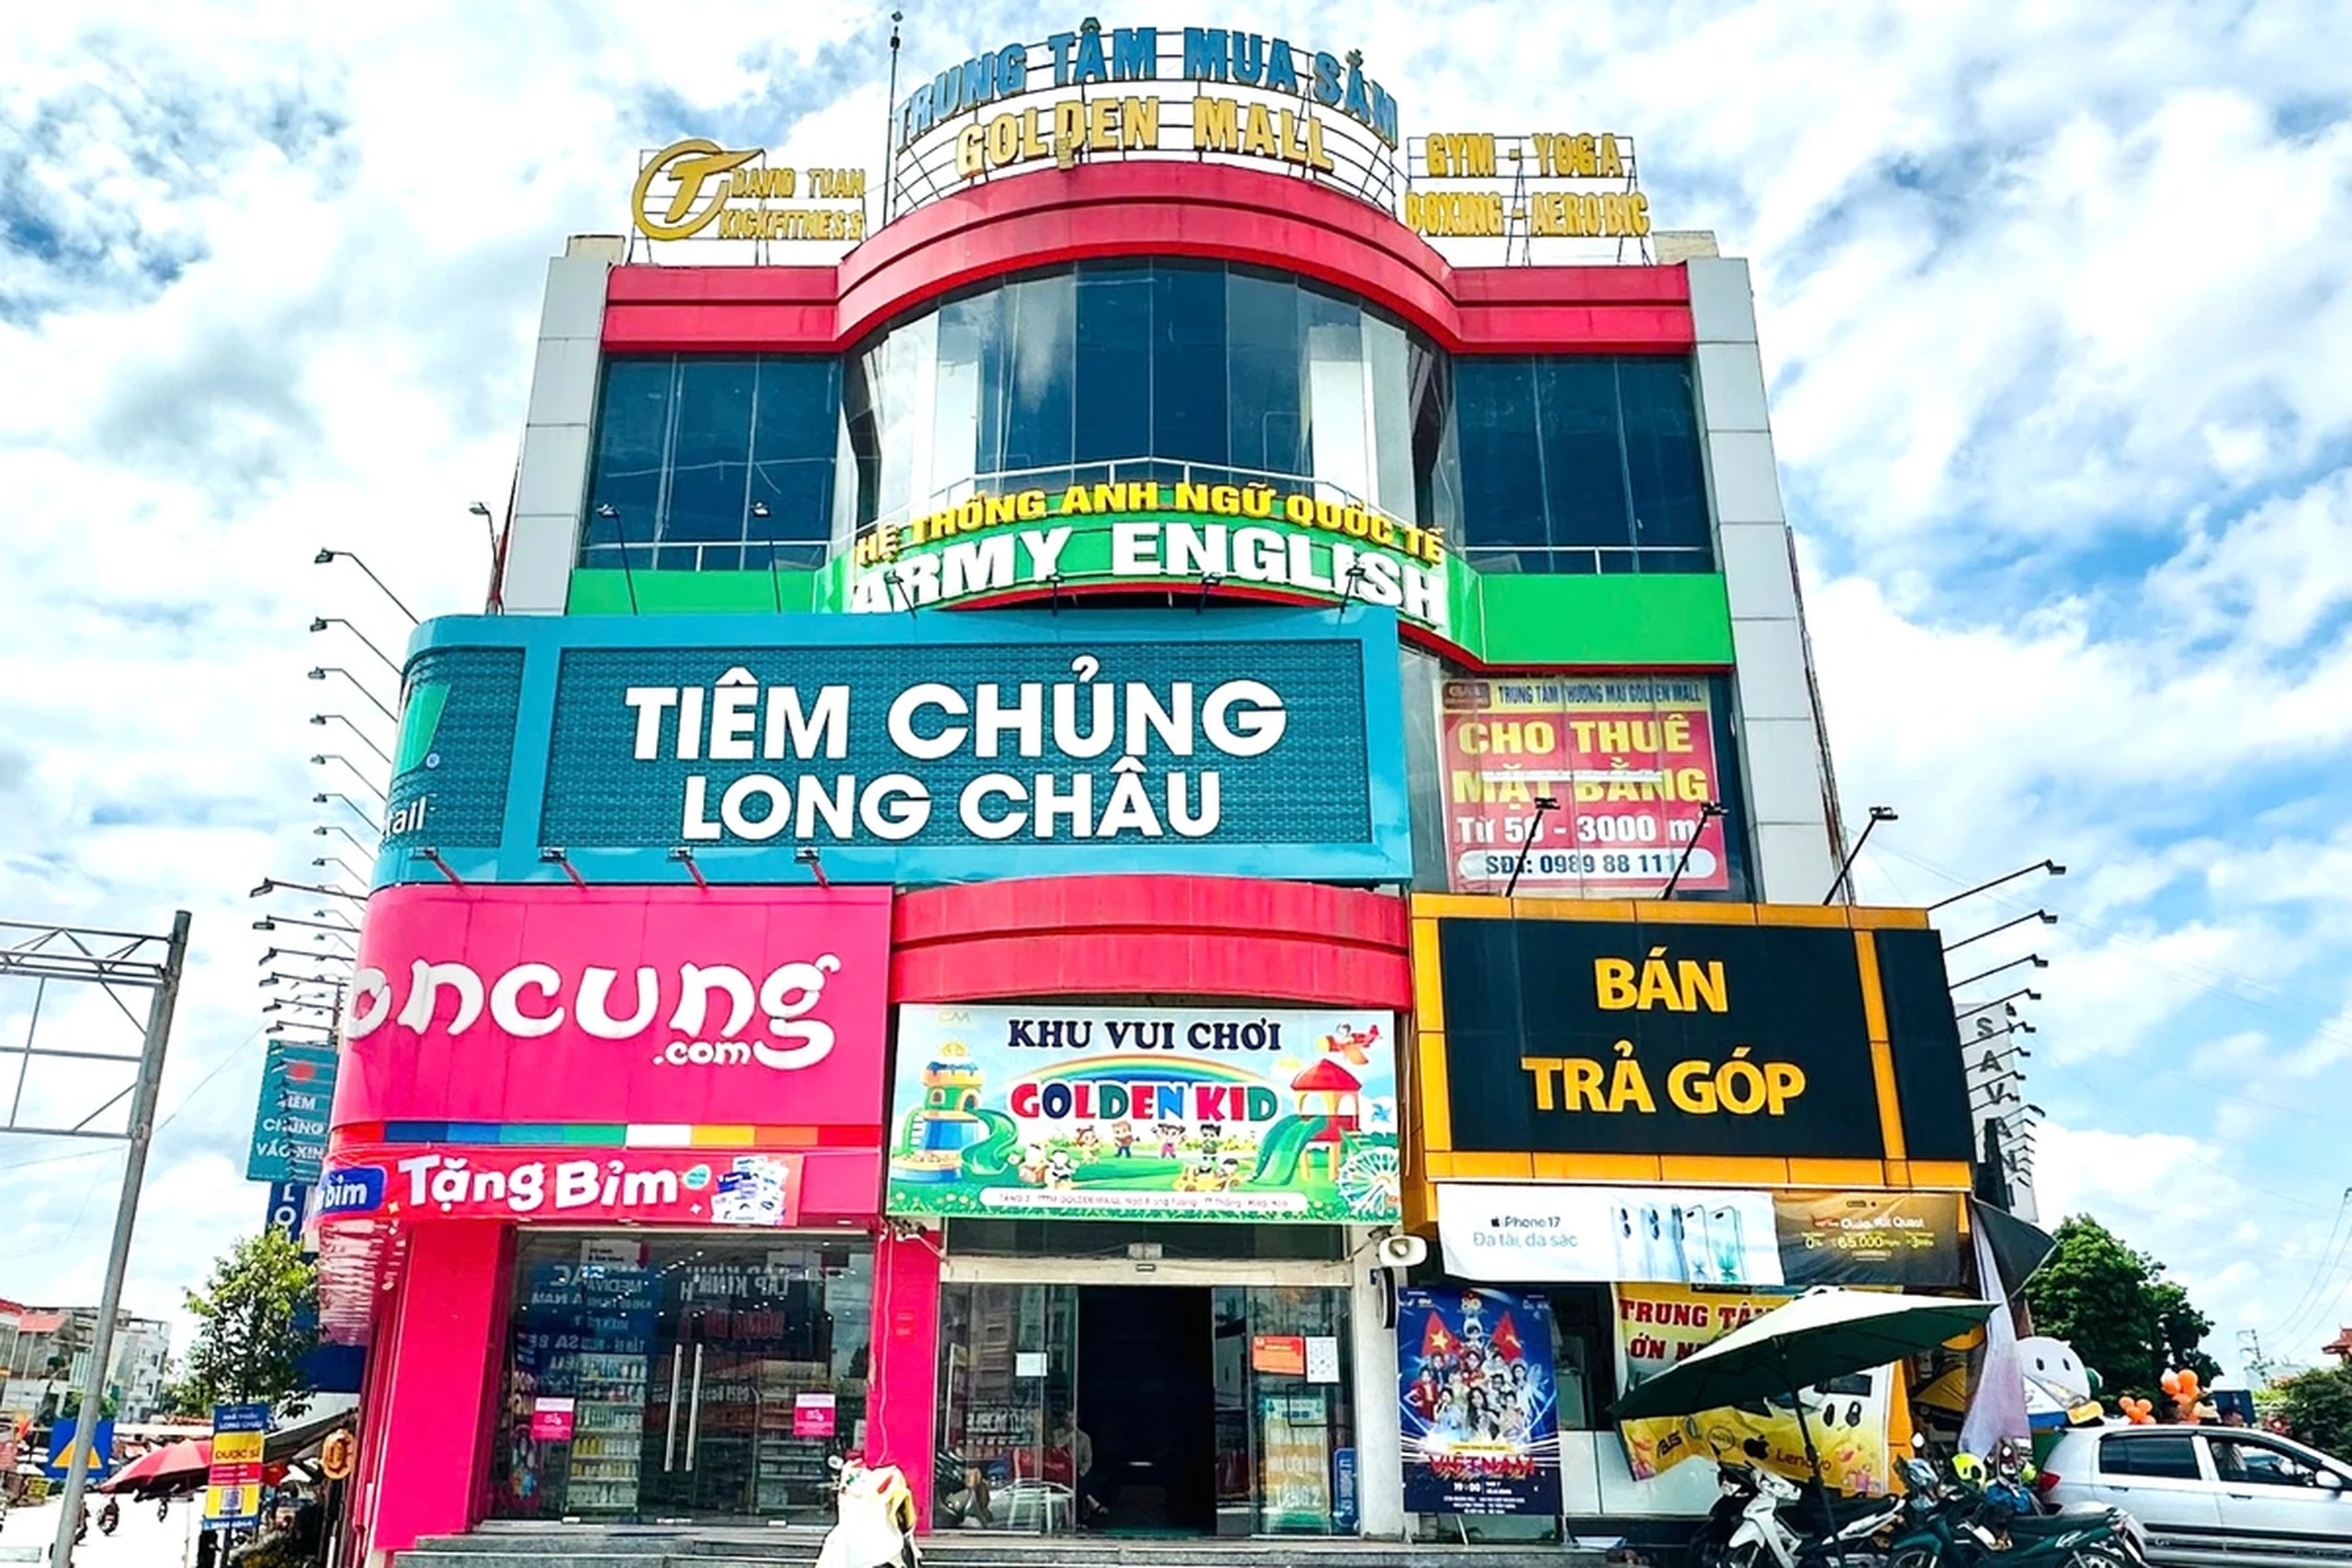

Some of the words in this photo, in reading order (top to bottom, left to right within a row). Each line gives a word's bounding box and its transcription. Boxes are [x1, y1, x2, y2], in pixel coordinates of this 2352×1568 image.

[893, 42, 1028, 152] TRUNG
[1047, 17, 1157, 85] TÂM
[1183, 27, 1298, 94] MUA
[956, 96, 1159, 179] GOLDEN
[1194, 96, 1334, 174] MALL
[1425, 133, 1498, 177] GYM
[1532, 133, 1623, 177] YOGA
[731, 168, 795, 197] DAVID
[808, 168, 865, 197] TUAN
[1405, 192, 1505, 236] BOXING
[1531, 192, 1650, 237] AEROBIC
[854, 524, 899, 567] HỆ
[912, 488, 1046, 541] THỐNG
[1061, 482, 1158, 515] ANH
[1176, 481, 1276, 519] NGỮ
[1286, 495, 1392, 546] QUỐC
[1403, 523, 1447, 567] TẾ
[851, 525, 1073, 615] ARMY
[1112, 522, 1448, 627] ENGLISH
[625, 667, 849, 761] TIÊM
[888, 654, 1286, 760] CHỦNG
[1458, 721, 1555, 755] CHO
[1569, 714, 1693, 753] THUÊ
[683, 773, 931, 842] LONG
[958, 755, 1222, 840] CHÂU
[1456, 815, 1495, 844] Từ
[1504, 817, 1544, 843] 50
[1577, 815, 1655, 842] 3000
[1540, 854, 1595, 873] 0989
[1603, 854, 1630, 873] 88
[1595, 947, 1728, 1012] BÁN
[653, 1040, 750, 1066] .com
[1008, 1019, 1092, 1051] KHU
[1107, 1021, 1175, 1051] VUI
[1187, 1018, 1282, 1052] CHƠI
[1521, 1041, 1656, 1114] TRẢ
[1667, 1047, 1806, 1116] GÓP
[1011, 1083, 1184, 1122] GOLDEN
[1195, 1086, 1278, 1122] KID
[397, 1154, 545, 1212] Tặng
[555, 1158, 678, 1209] Bỉm
[1500, 1215, 1547, 1227] iPhone
[1548, 1216, 1561, 1227] 17
[1619, 1298, 1709, 1327] TRUNG
[1718, 1302, 1775, 1329] TÂ
[1776, 1448, 1831, 1471] Lenoo
